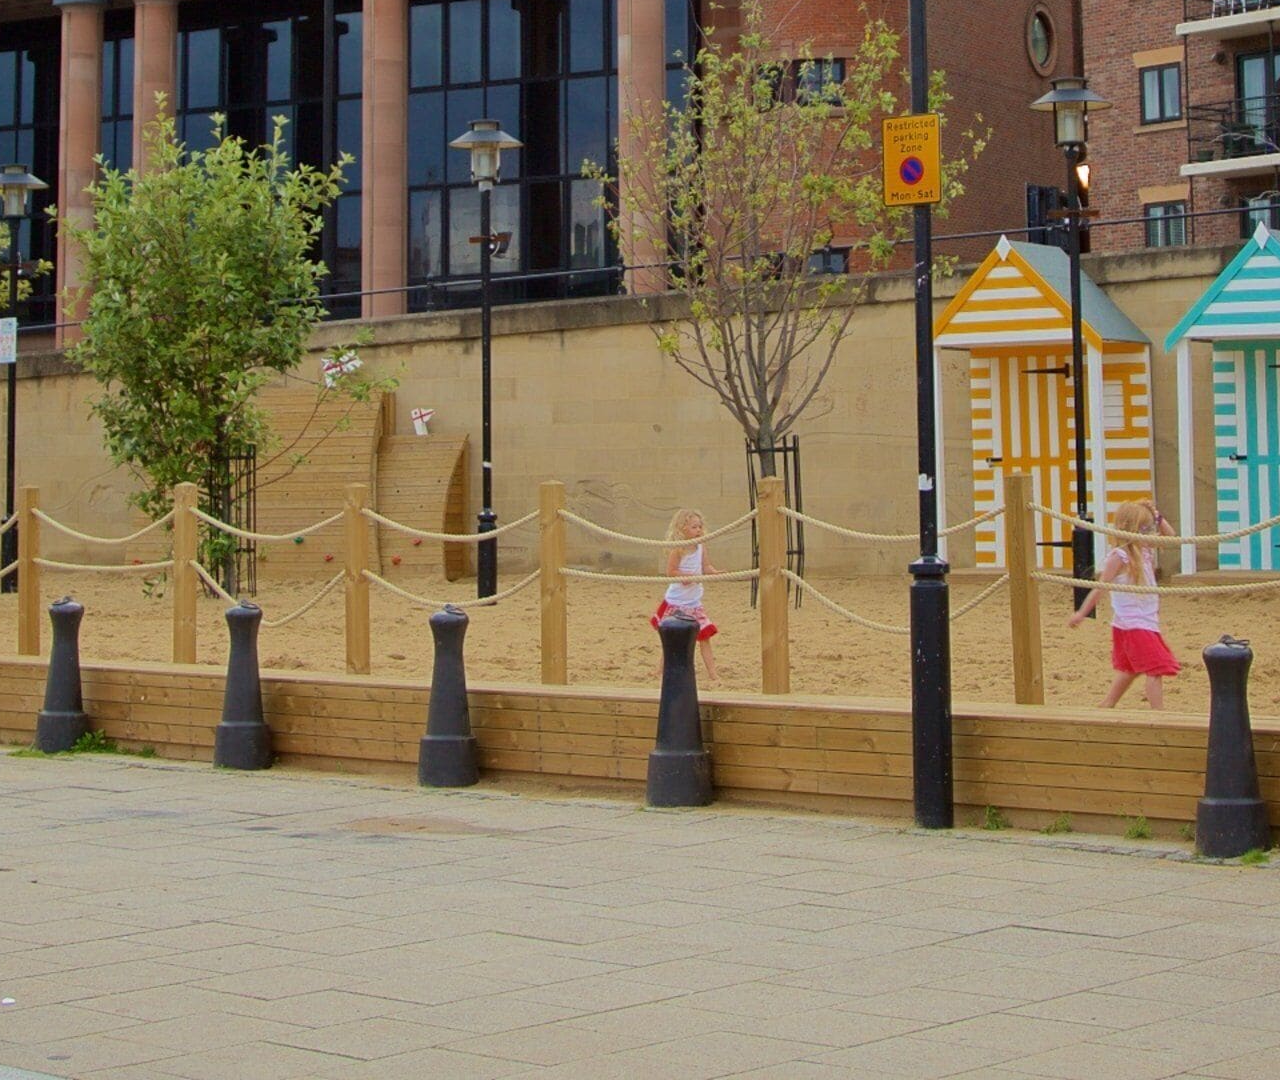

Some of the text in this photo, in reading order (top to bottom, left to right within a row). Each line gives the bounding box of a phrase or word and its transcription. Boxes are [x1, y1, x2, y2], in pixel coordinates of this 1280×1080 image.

[887, 118, 935, 131] Restricted
[893, 131, 928, 143] parking
[900, 144, 922, 153] Zone
